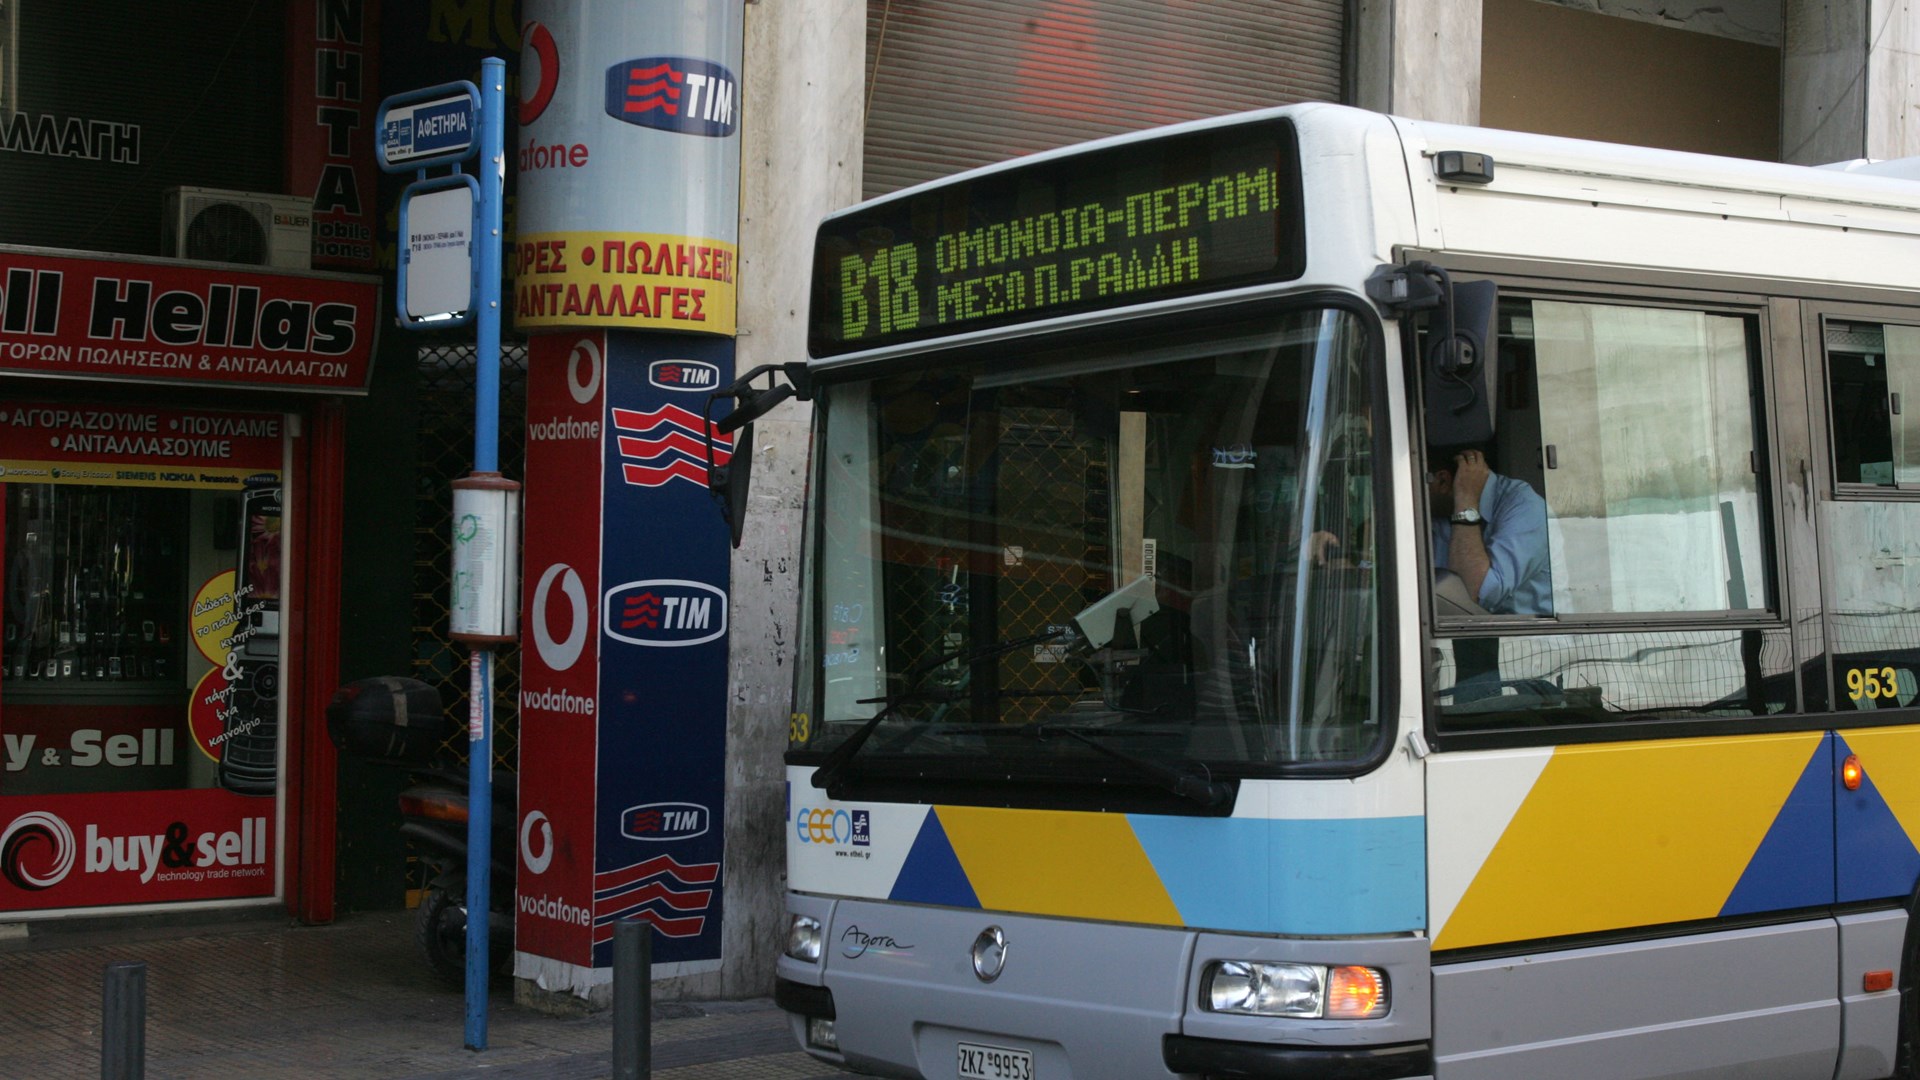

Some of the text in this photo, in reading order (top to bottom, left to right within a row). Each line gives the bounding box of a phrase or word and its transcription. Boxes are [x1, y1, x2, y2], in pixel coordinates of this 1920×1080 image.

[686, 73, 734, 126] TIM
[417, 111, 467, 139] ΑΦΕΤΗΡΙΑ
[603, 241, 732, 284] ΠΩΛΗΣΕΙΣ
[0, 266, 357, 356] ll Hellas
[519, 284, 706, 321] ΑΝΤΑΛΛΑΓΕΣ
[77, 346, 193, 370] ΠΩΛΗΣΕΩΝ
[198, 352, 212, 371] &
[216, 355, 348, 379] ΑΝΤΑΛΛΑΓΩΝ
[682, 368, 711, 385] TIM
[12, 408, 279, 439] ΑΓΟΡΑΖΟΥΜΕ ΠΟΥΛΑΜΕ
[529, 415, 600, 441] vodafone
[63, 434, 231, 458] ΑΝΤΑΛΛΑΣΟΥΜΕ
[116, 471, 156, 481] SIEMENS
[160, 472, 195, 482] NOKIA
[663, 596, 711, 630] TIM
[196, 626, 209, 638] το
[222, 652, 244, 681] &
[1847, 666, 1898, 701] 953
[523, 687, 594, 715] vodafone
[41, 747, 61, 766] &
[70, 728, 174, 767] Sell
[662, 811, 698, 831] TIM
[157, 867, 265, 883] technology trade network
[519, 893, 590, 926] vodafone
[841, 924, 914, 959] Agora
